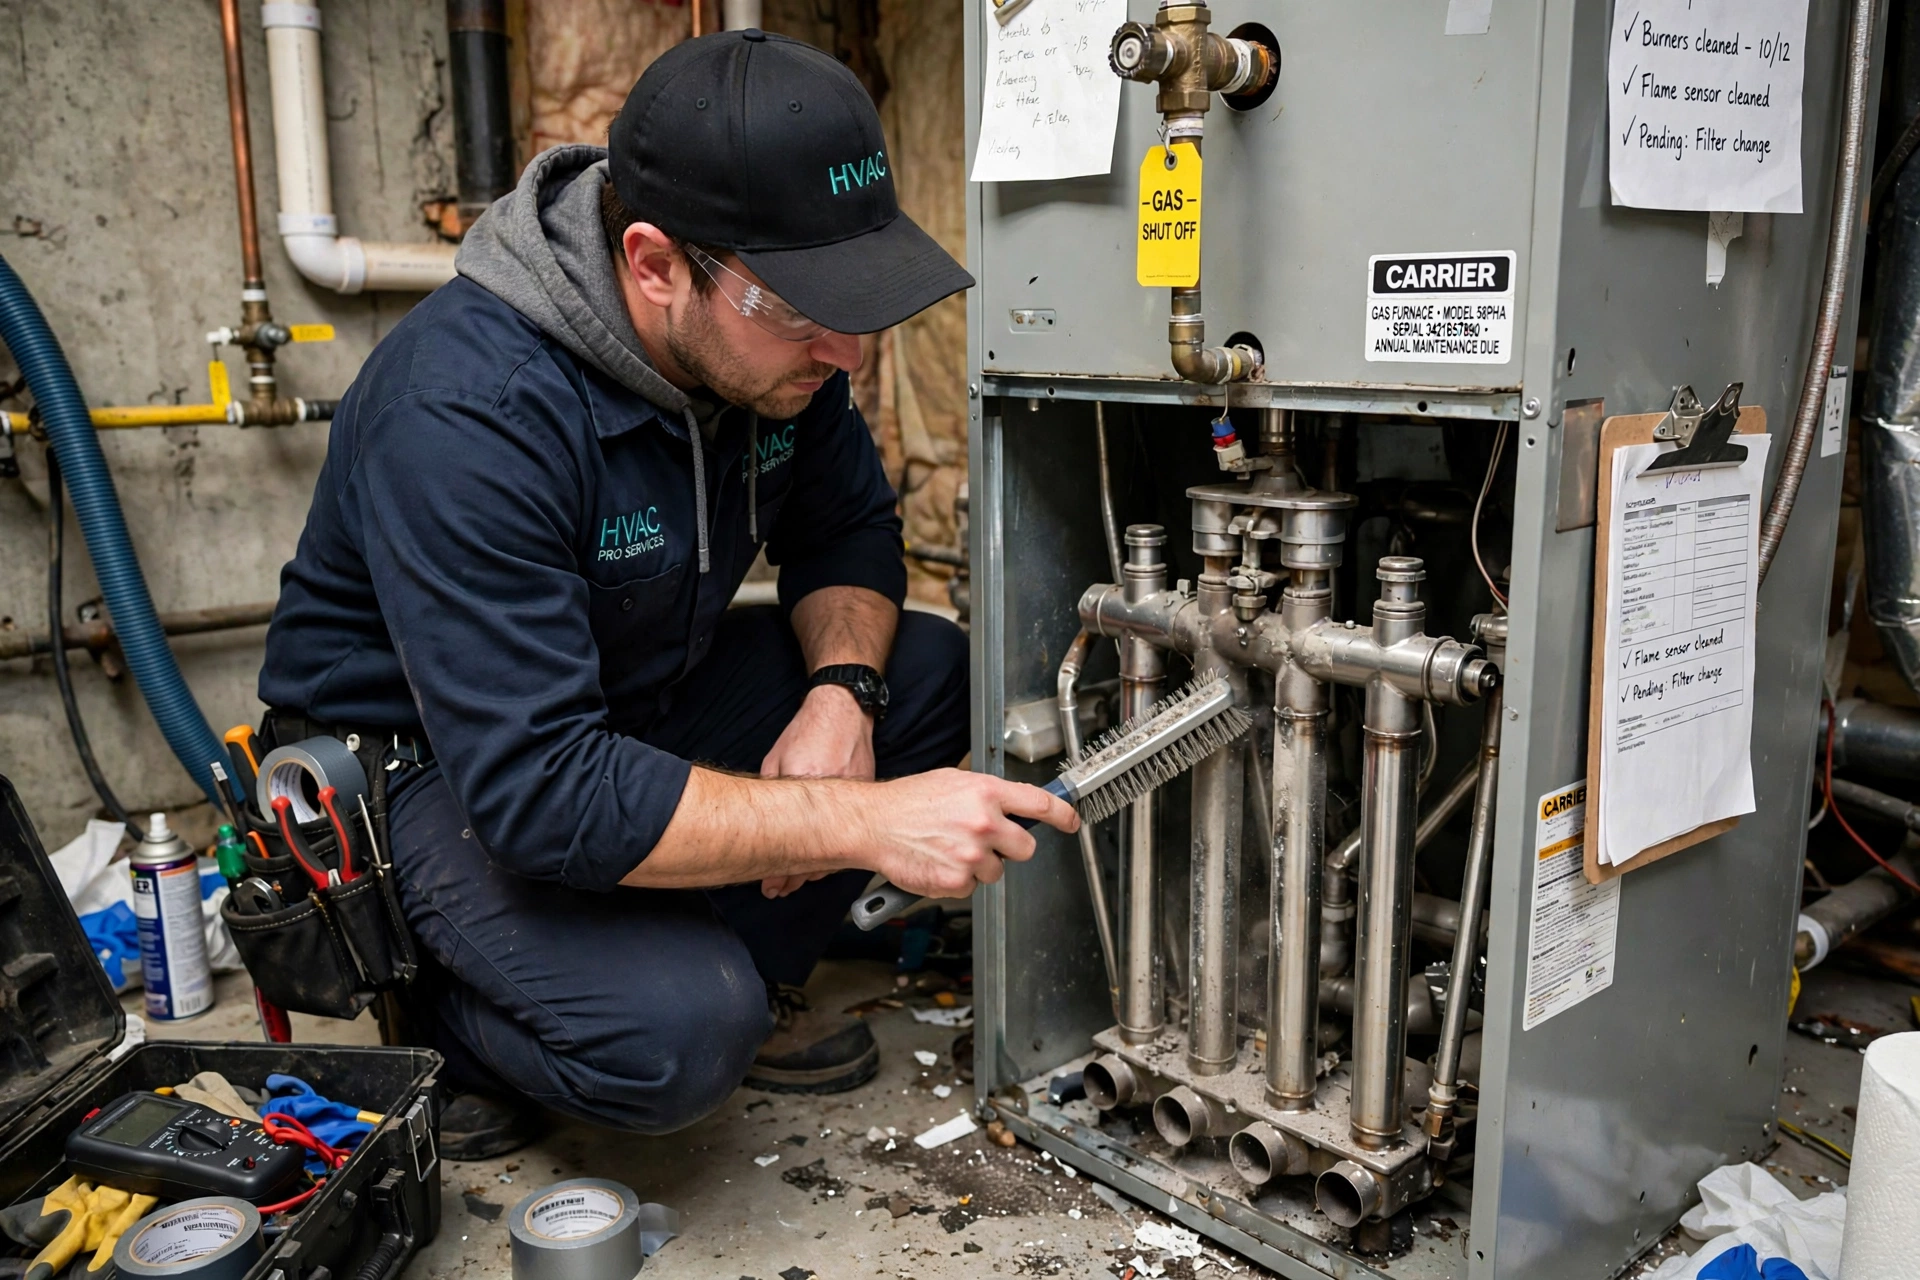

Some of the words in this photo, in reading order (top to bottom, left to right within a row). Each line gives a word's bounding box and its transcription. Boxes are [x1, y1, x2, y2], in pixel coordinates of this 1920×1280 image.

[1642, 20, 1689, 51] Burners
[1695, 28, 1739, 55] cleaned
[1759, 31, 1791, 68] 10/12
[1641, 72, 1678, 100] Flame
[1684, 85, 1722, 103] sensor
[1727, 81, 1771, 107] cleaned
[1639, 122, 1688, 161] Pending:
[1696, 127, 1727, 151] Filter
[1733, 129, 1771, 163] change
[829, 150, 886, 195] HVAC
[1142, 222, 1172, 241] SHUT
[1174, 221, 1197, 240] OFF
[1386, 262, 1496, 289] CARRIER
[1371, 305, 1391, 320] GAS
[1392, 305, 1434, 320] FURNACE
[1442, 305, 1474, 320] MODEL
[1374, 338, 1411, 353] ANNUAL
[1412, 339, 1478, 354] MAINTENANCE
[1480, 340, 1500, 354] DUE
[600, 506, 661, 547] HVAC
[597, 548, 623, 561] PRO
[624, 534, 665, 558] SERVICES
[1635, 648, 1660, 667] Flame
[1665, 642, 1692, 659] sensor
[1694, 628, 1724, 650] cleaned
[1633, 680, 1668, 701] Pending:
[1672, 671, 1695, 689] Filter
[1698, 666, 1723, 684] change
[1544, 786, 1587, 817] CARRIE
